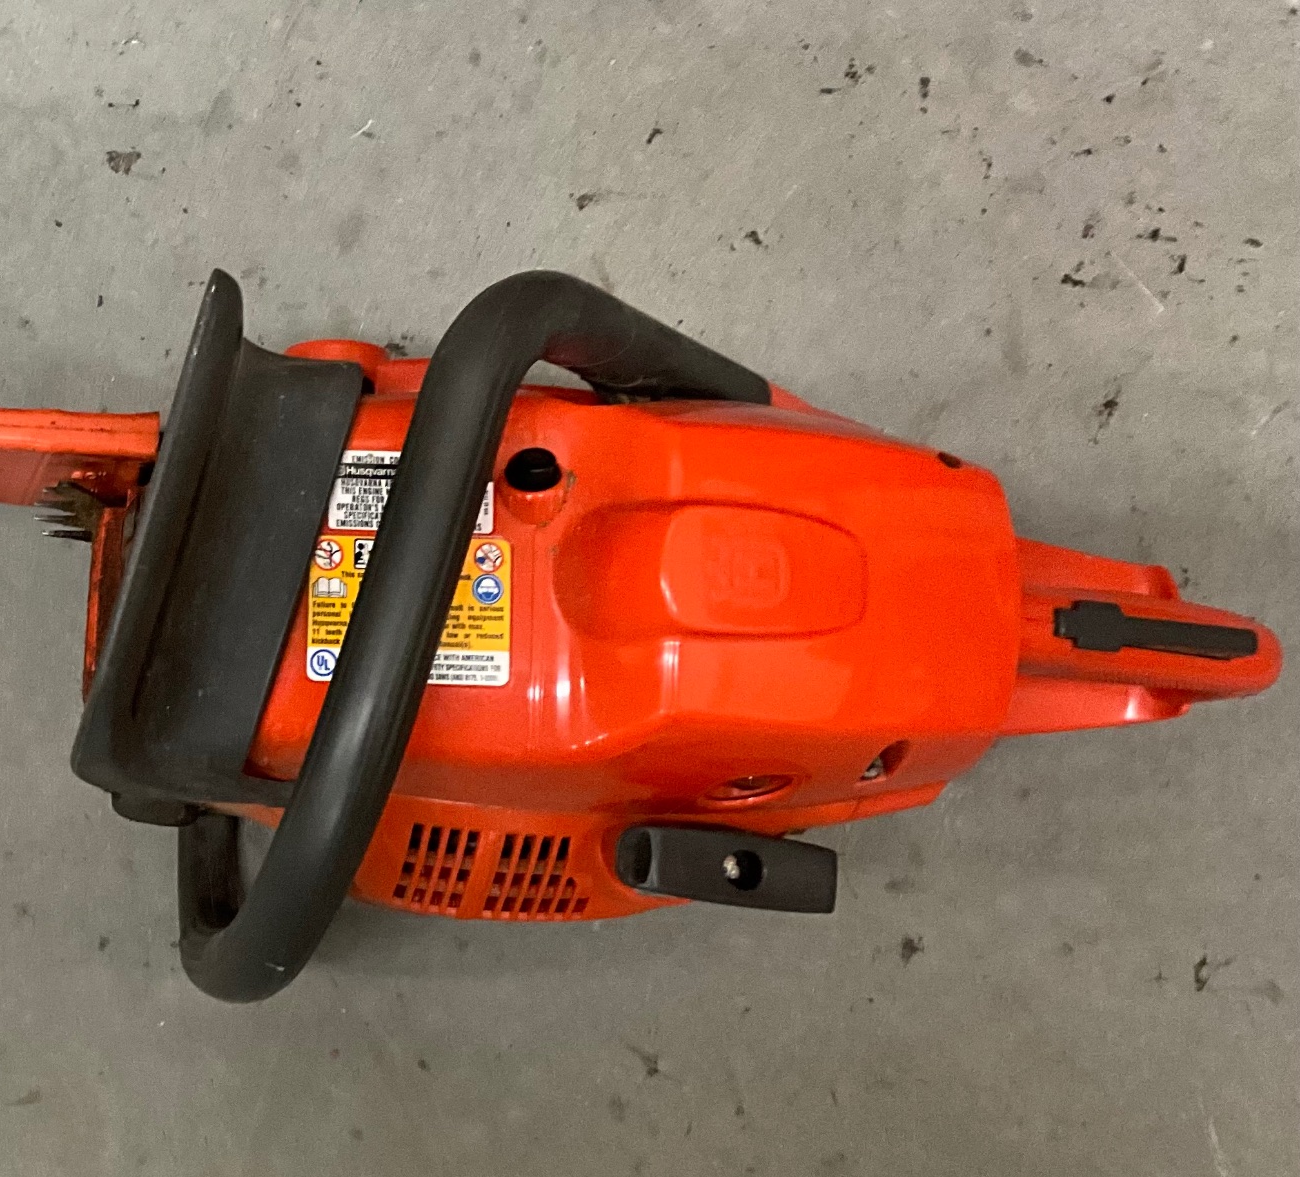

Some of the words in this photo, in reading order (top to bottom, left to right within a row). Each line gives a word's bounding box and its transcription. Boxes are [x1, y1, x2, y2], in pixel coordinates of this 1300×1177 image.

[341, 487, 356, 495] THIS
[358, 487, 383, 496] ENGINE
[372, 496, 385, 504] FOR
[336, 519, 374, 528] EMISSIONS
[316, 655, 331, 671] UL
